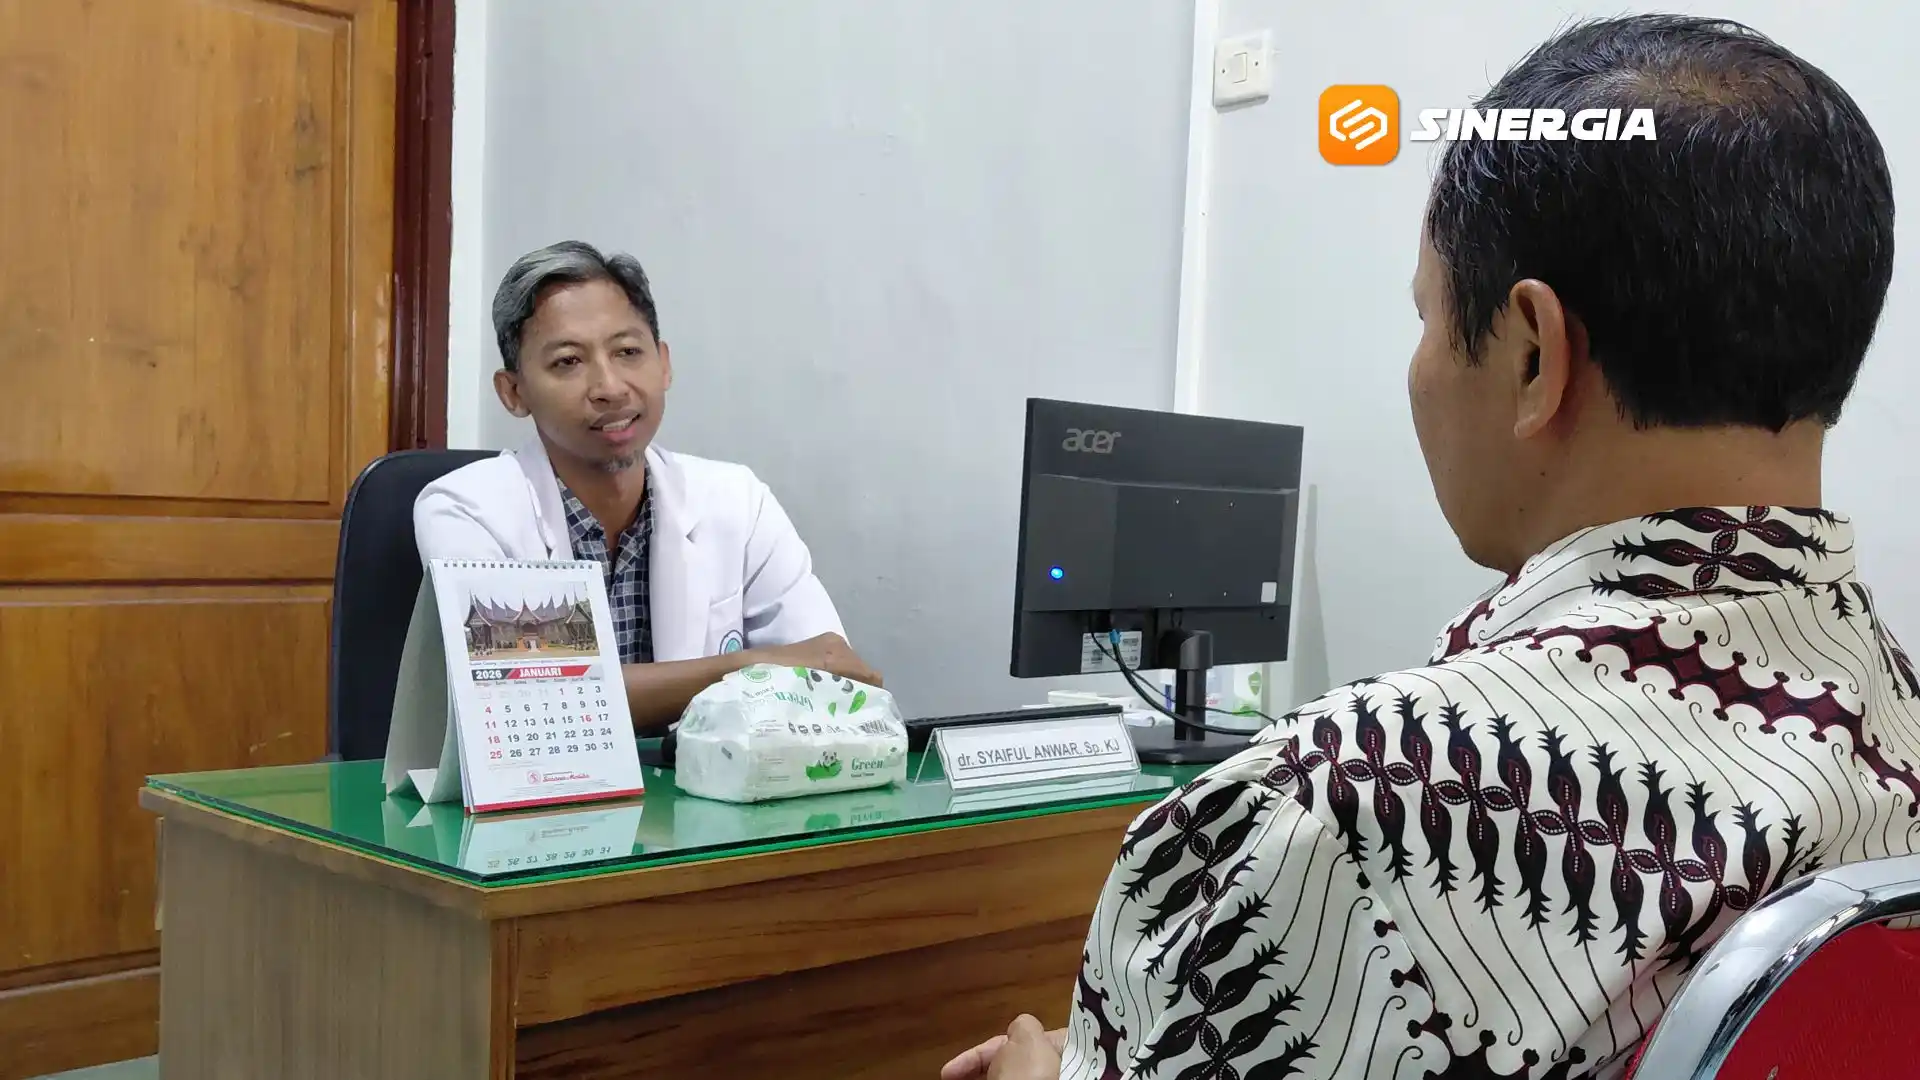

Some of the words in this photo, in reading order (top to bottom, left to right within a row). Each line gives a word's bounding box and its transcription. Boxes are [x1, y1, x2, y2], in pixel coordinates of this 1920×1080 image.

[1062, 428, 1122, 453] acer
[475, 670, 502, 680] 2026
[520, 667, 562, 678] JANUARI
[577, 686, 584, 694] 2
[595, 685, 602, 693] 3
[485, 706, 492, 714] 4
[504, 705, 511, 713] 5
[524, 704, 530, 712] 6
[580, 700, 586, 708] 9
[485, 721, 496, 729] 11
[505, 720, 517, 728] 12
[562, 716, 573, 724] 15
[488, 736, 500, 744] 18
[508, 734, 520, 742] 19
[527, 733, 539, 741] 20
[546, 732, 556, 740] 21
[564, 730, 576, 738] 22
[600, 728, 612, 736] 24
[490, 751, 502, 759] 25
[510, 749, 522, 758] 26
[529, 748, 540, 756] 27
[548, 746, 560, 754] 28
[585, 743, 597, 751] 30
[603, 742, 613, 750] 31
[958, 753, 975, 767] dr.
[978, 747, 1032, 765] SYAIFUL
[1083, 741, 1104, 756] Sp.
[1104, 738, 1120, 751] KJ
[851, 757, 884, 771] Green
